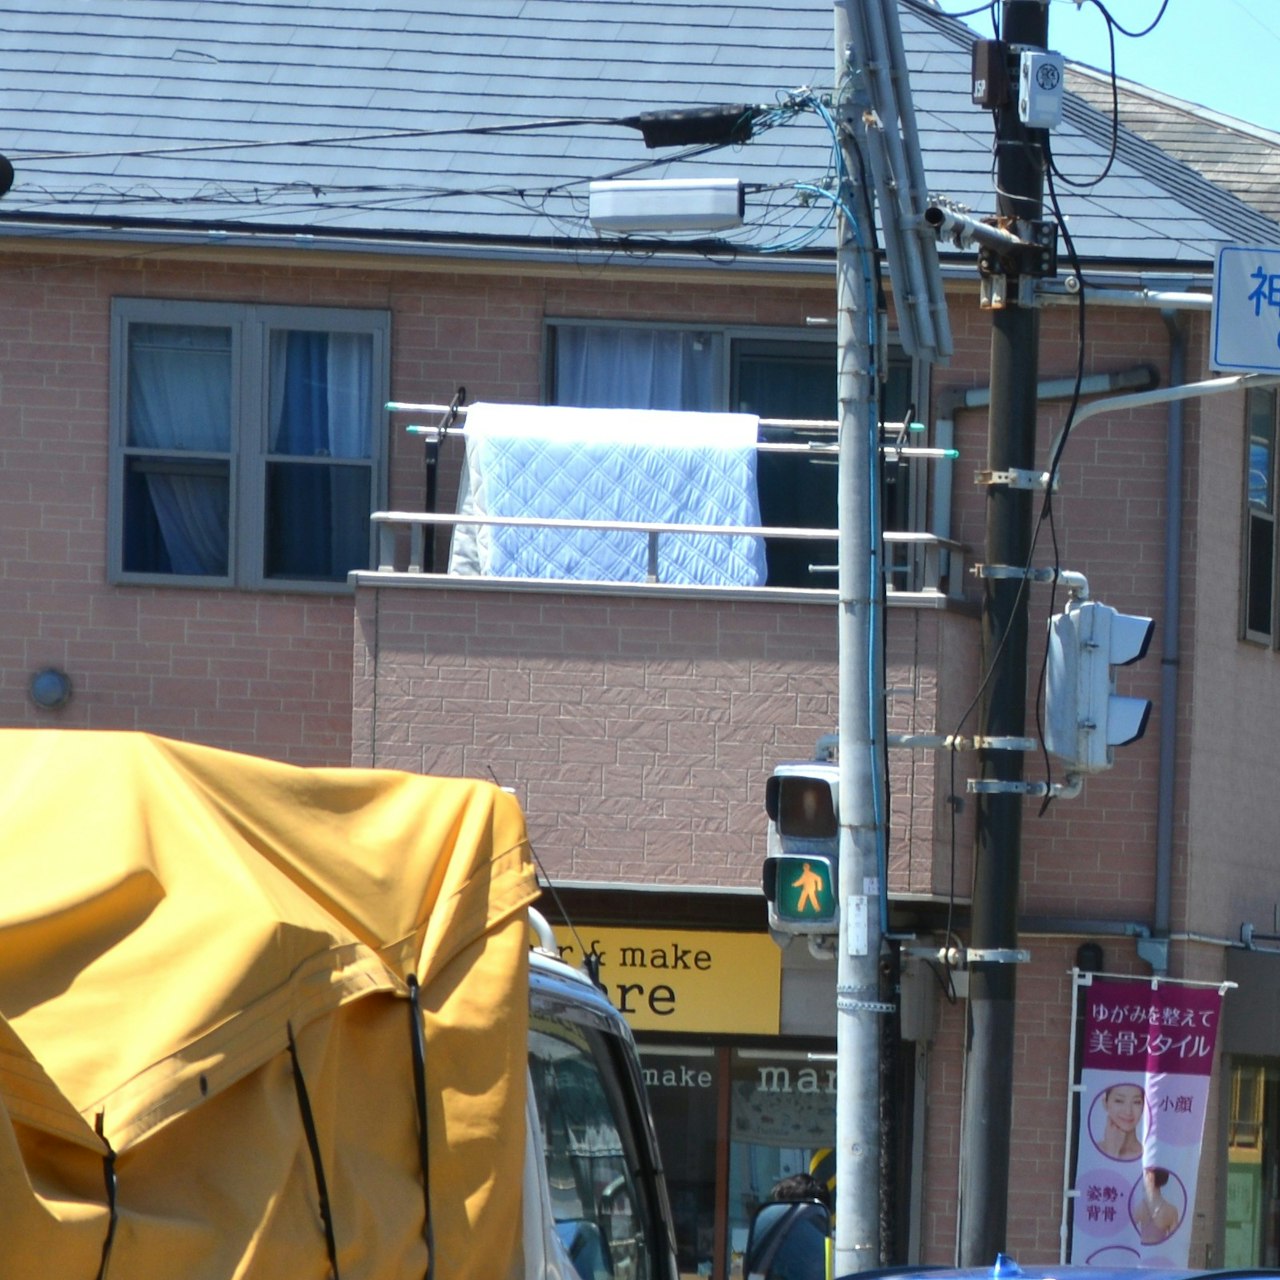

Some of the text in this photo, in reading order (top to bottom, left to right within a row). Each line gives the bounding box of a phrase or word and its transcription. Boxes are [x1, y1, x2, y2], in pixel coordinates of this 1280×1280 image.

[619, 943, 713, 971] make
[1093, 1003, 1214, 1027] ゆがみを整えて
[1090, 1029, 1210, 1058] 美骨スタイル
[1159, 1095, 1194, 1112] 小顔
[1087, 1204, 1117, 1222] 背骨
